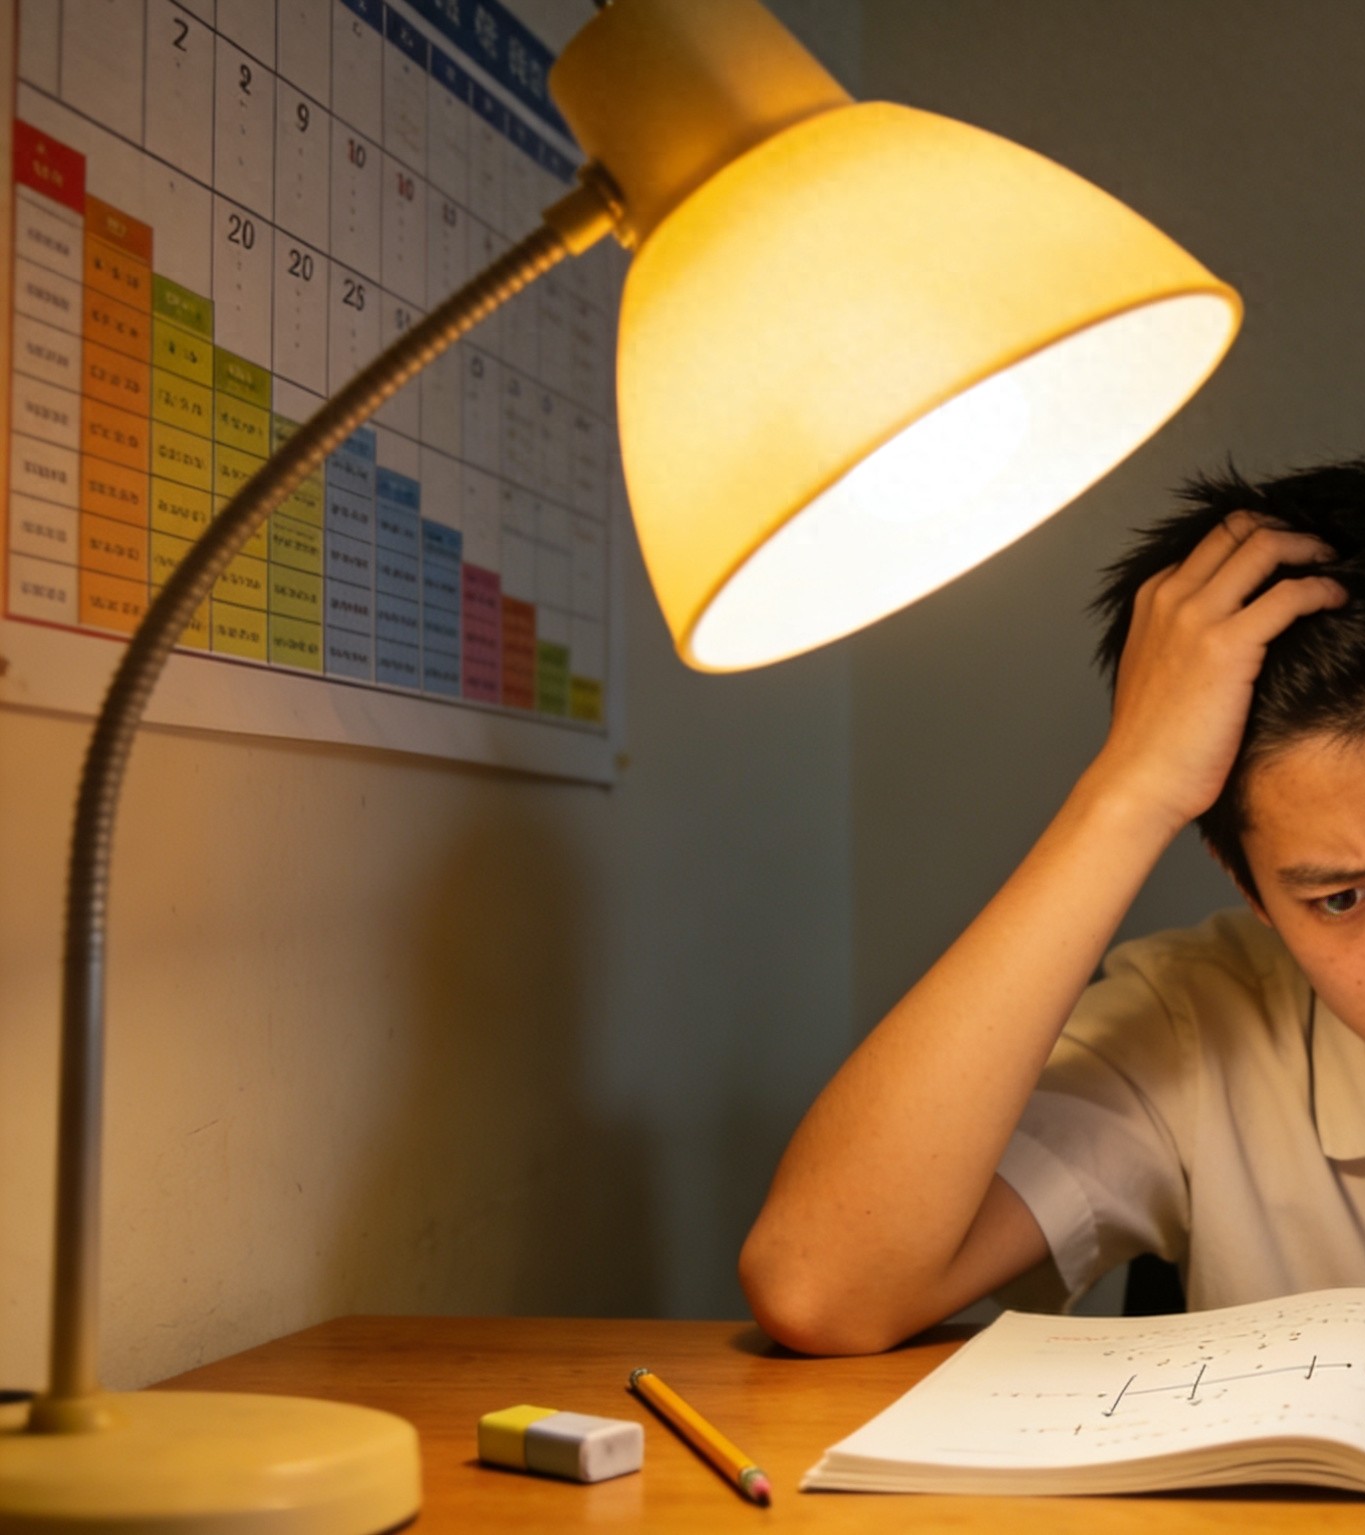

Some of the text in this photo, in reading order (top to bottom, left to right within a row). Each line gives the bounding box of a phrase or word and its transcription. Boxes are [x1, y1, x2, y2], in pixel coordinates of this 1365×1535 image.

[172, 18, 190, 52] 2
[297, 103, 310, 132] 9
[227, 214, 255, 250] 20
[288, 250, 314, 281] 20
[342, 279, 365, 311] 25
